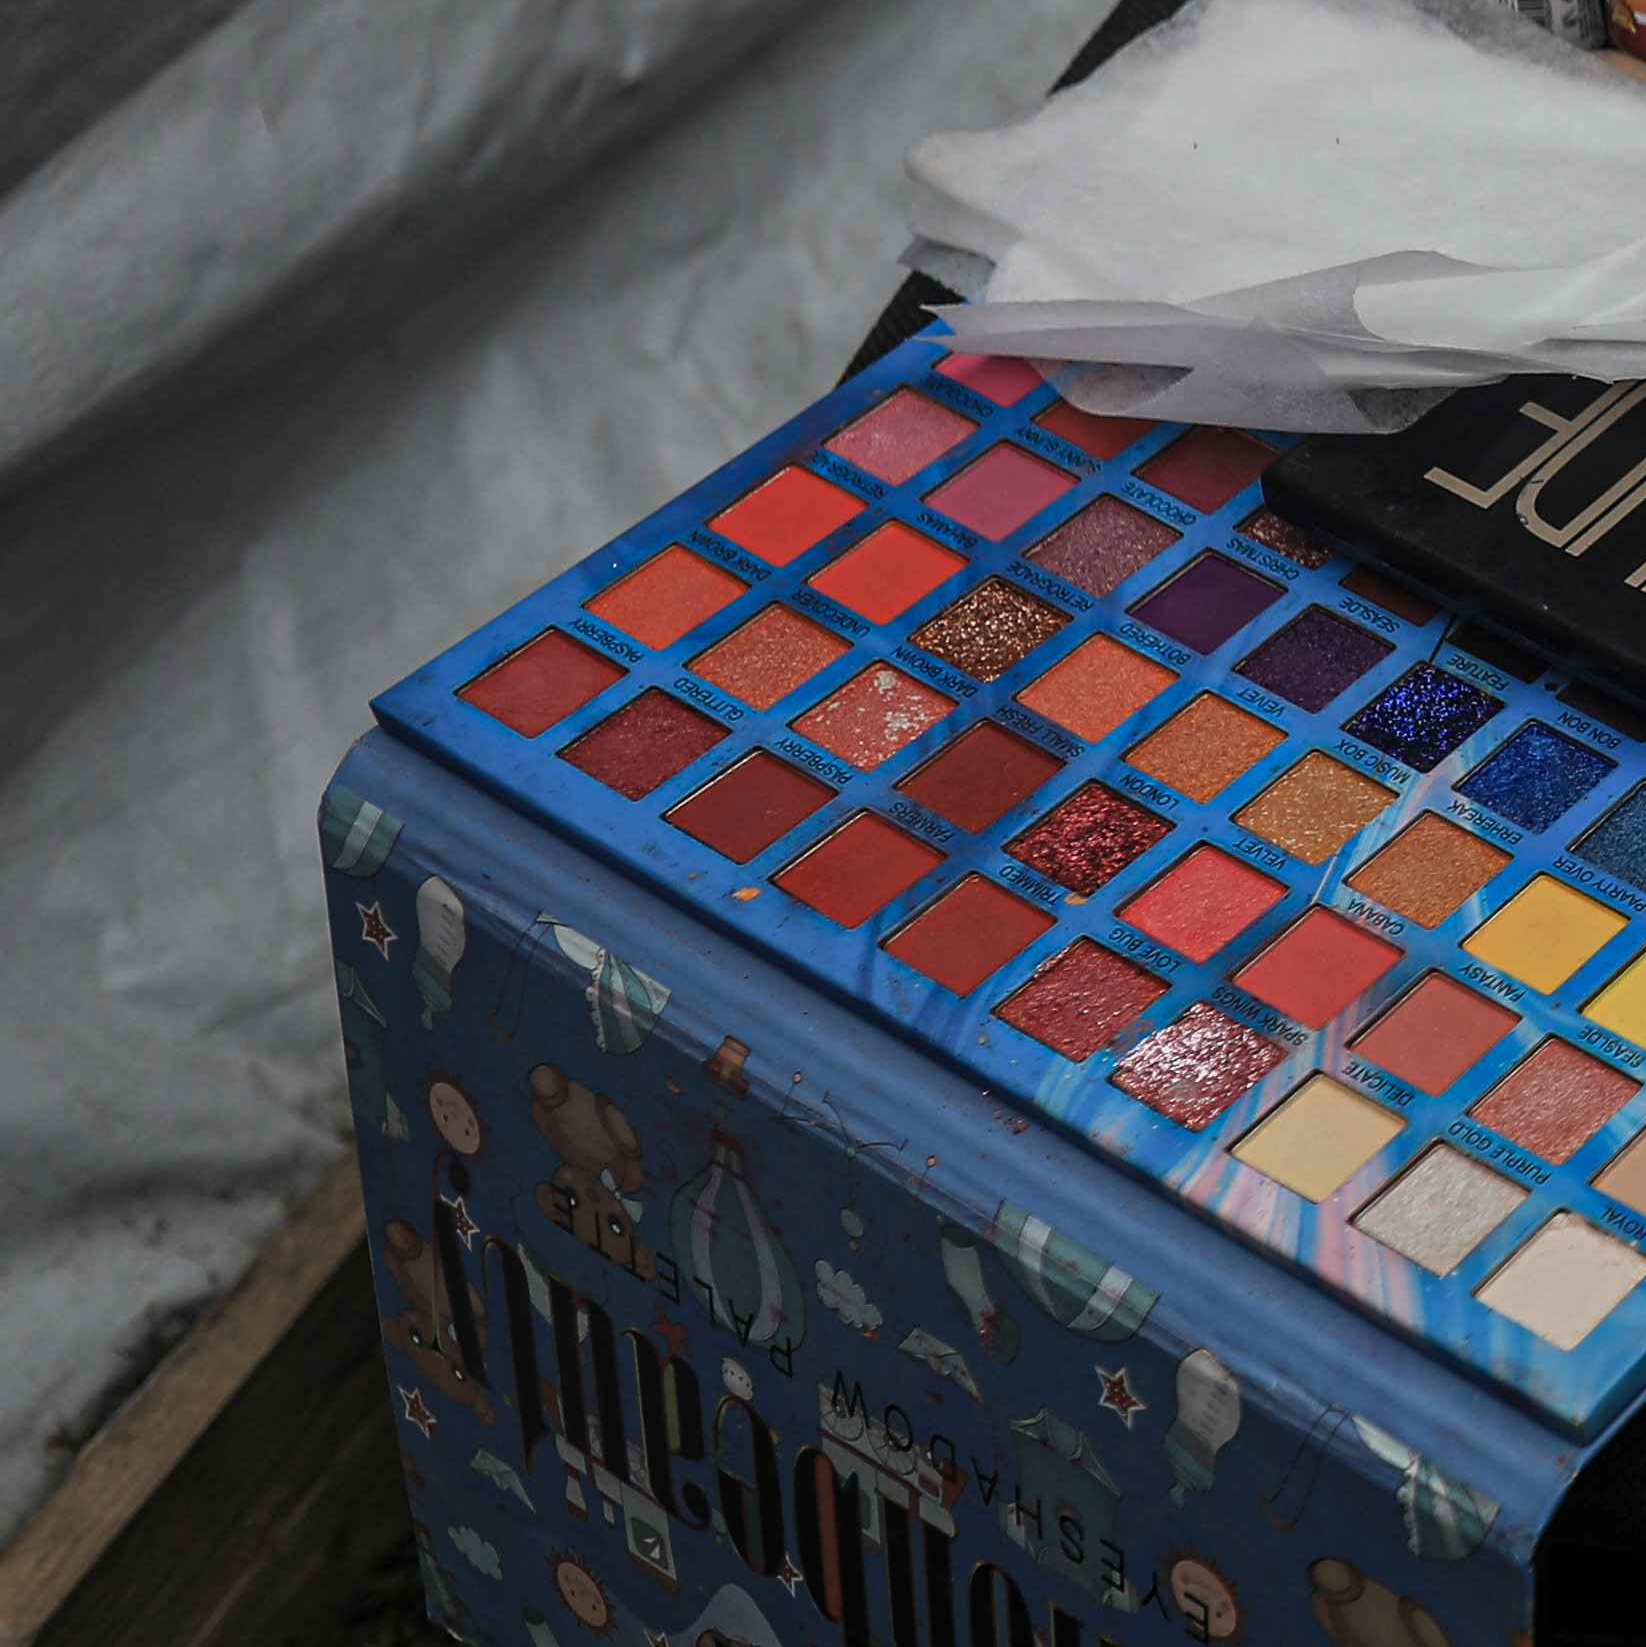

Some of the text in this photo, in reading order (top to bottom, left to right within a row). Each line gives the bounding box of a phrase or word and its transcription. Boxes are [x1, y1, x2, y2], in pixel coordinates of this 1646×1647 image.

[1119, 481, 1197, 526] CHOCOLATE
[1224, 537, 1300, 581] CHRISTMAS
[1003, 560, 1094, 613] RETROGRADE
[1119, 621, 1191, 666] BOTHERED
[890, 646, 979, 698] DARK BROWN
[1445, 653, 1510, 691] FEATURE
[673, 676, 745, 722] GLITTERED
[995, 705, 1085, 757] SMALL FRESH
[1557, 711, 1621, 749] BON BON
[1333, 738, 1411, 785] MUSIC BOX
[1118, 774, 1180, 811] LONDON
[888, 801, 955, 842] FARMERS
[1231, 837, 1286, 872] VELVET
[1552, 855, 1593, 884] OVER
[999, 865, 1062, 905] TRIMMED
[1346, 898, 1405, 936] CABANA
[1107, 927, 1180, 973] LOVE BUG
[1459, 963, 1526, 1002] FANTASY
[1209, 987, 1308, 1046] SPARK WINGS
[1340, 1062, 1414, 1106] DELICATE
[1447, 1121, 1552, 1185] PURPLE GOLD
[552, 1185, 1209, 1645] EYESHADOW PALETTE
